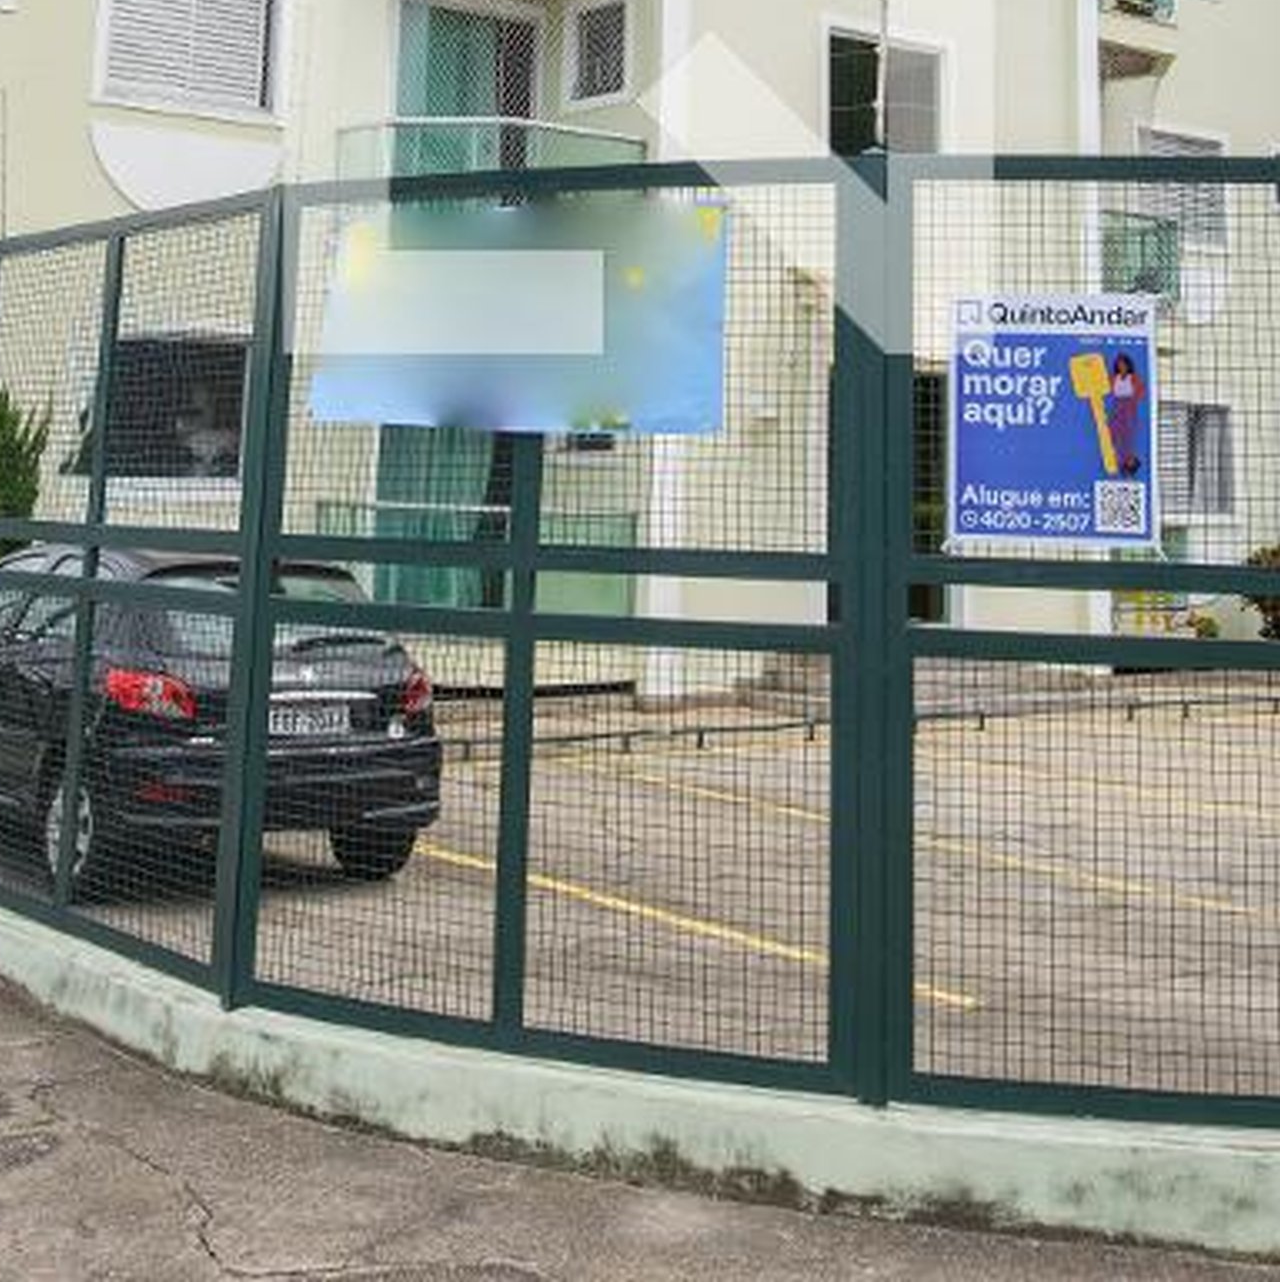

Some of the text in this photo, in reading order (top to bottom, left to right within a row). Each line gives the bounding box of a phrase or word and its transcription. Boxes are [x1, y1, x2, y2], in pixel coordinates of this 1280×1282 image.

[988, 302, 1147, 325] QuintoAndar
[962, 339, 1047, 368] Quer
[962, 372, 1062, 397] morar
[962, 397, 1054, 428] aqui?
[960, 483, 1091, 511] Alugue em:
